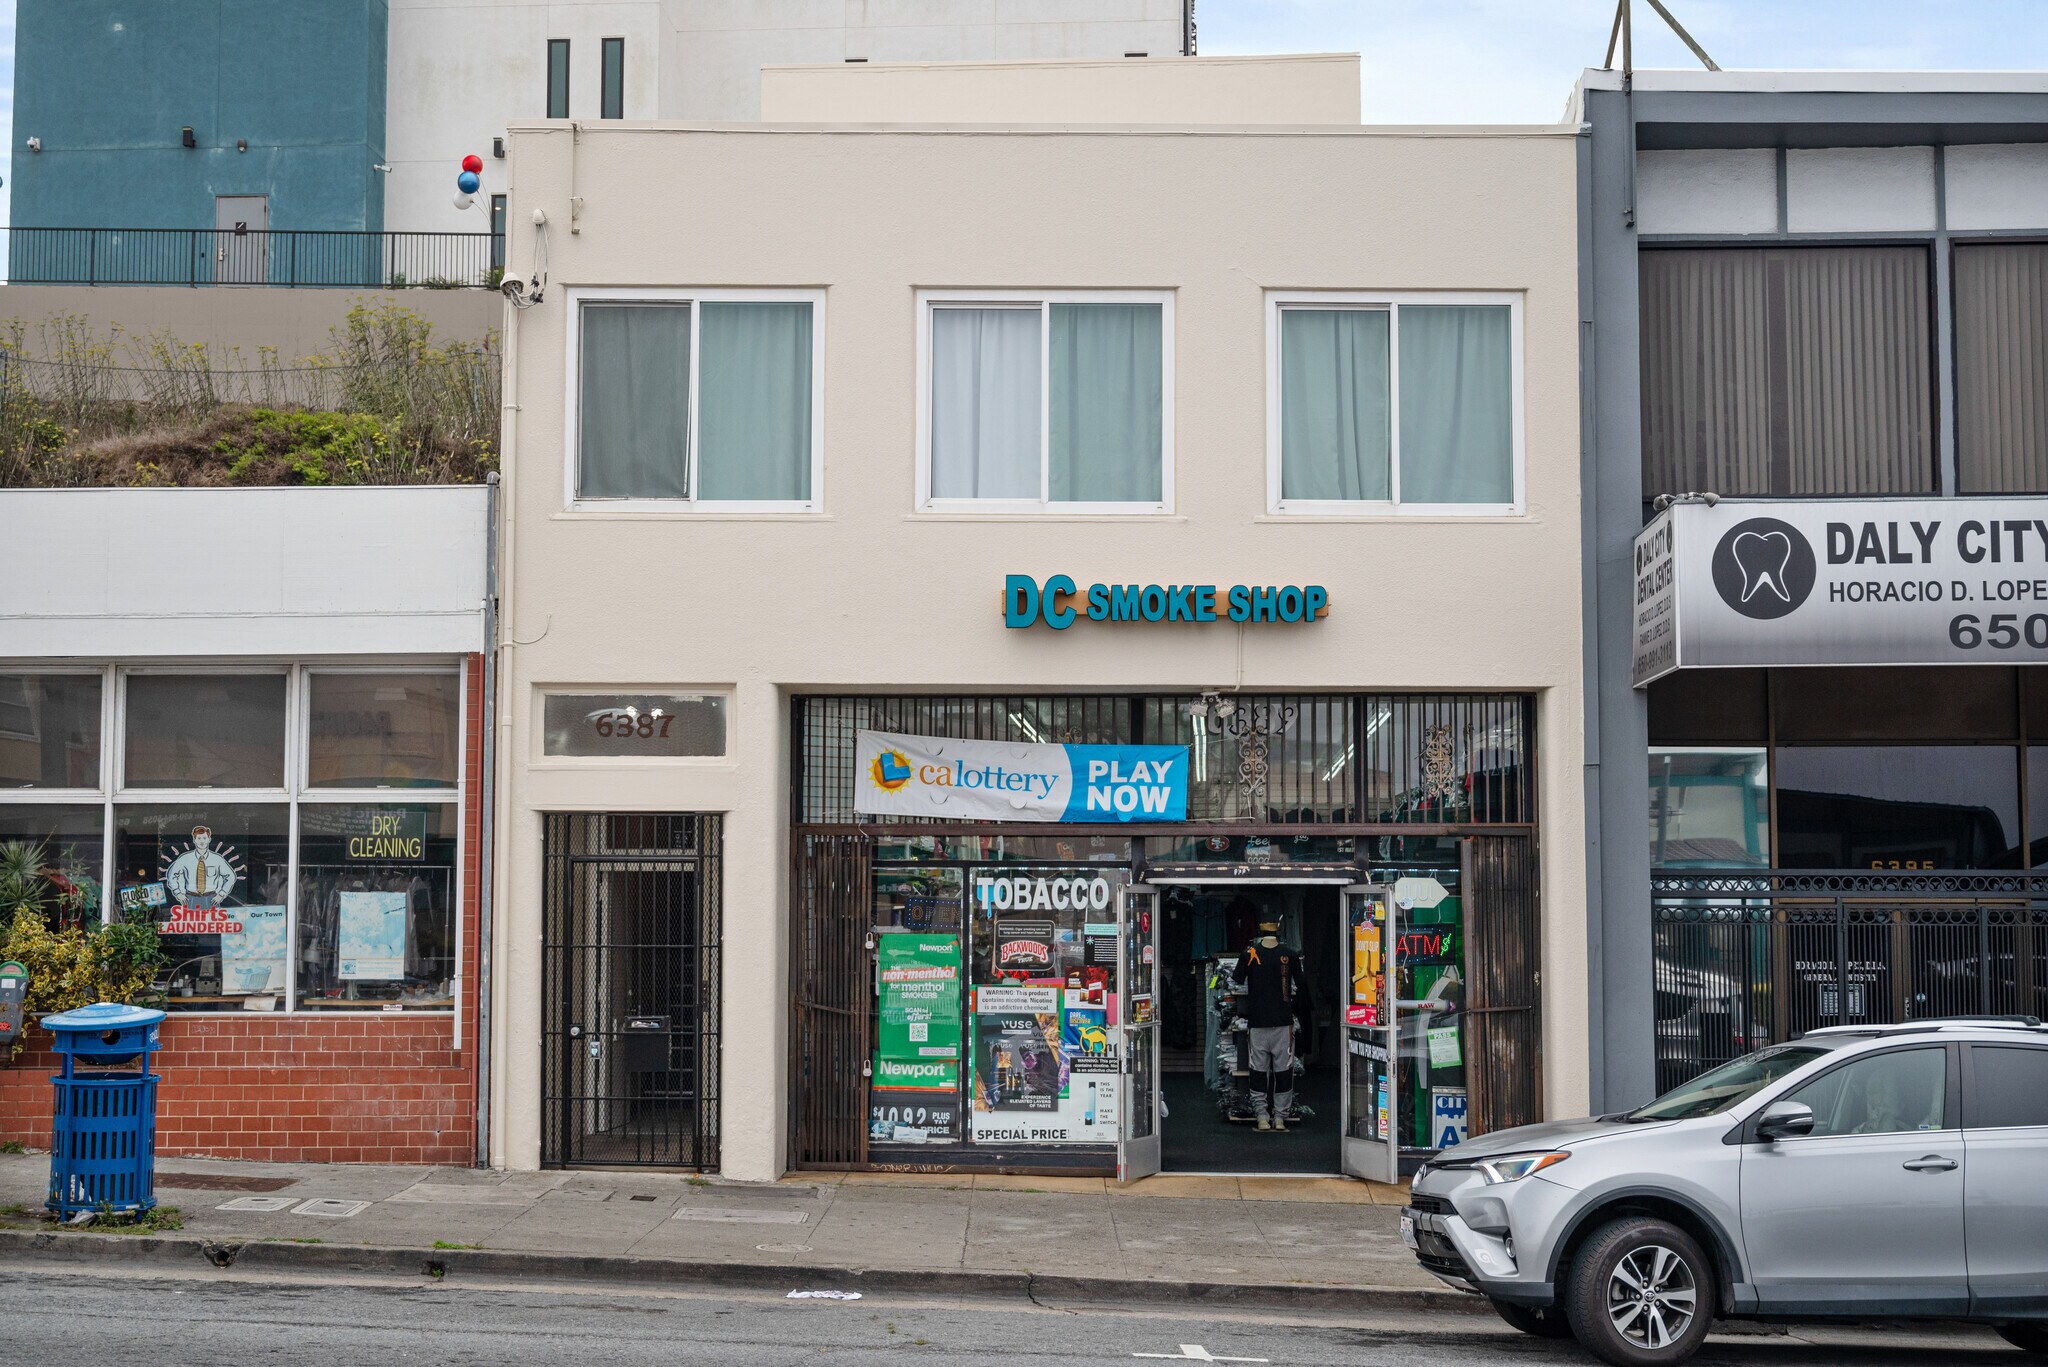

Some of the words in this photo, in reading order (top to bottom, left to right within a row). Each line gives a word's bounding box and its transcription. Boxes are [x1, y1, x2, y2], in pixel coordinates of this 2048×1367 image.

[1643, 535, 1654, 568] DALY
[1654, 526, 1666, 558] CITY
[1827, 521, 1941, 564] DALY
[1638, 572, 1654, 606] DENTAL
[1655, 557, 1672, 593] CENTER
[1830, 580, 1942, 602] HORACIO
[1951, 580, 1974, 601] D.
[1006, 574, 1077, 630] DC
[1087, 584, 1218, 622] SMOKE
[1228, 584, 1328, 622] SHOP
[1949, 614, 2048, 650] 650
[596, 712, 676, 738] 6387
[920, 760, 1059, 800] calottery
[1088, 760, 1174, 784] PLAY
[1086, 785, 1172, 814] NOW
[372, 816, 400, 836] DRY
[350, 838, 421, 858] CLEANING
[122, 890, 148, 902] CLOSED
[976, 877, 1110, 910] TOBACCO
[170, 904, 228, 922] Shirts
[912, 906, 961, 922] OPEN
[158, 922, 243, 933] LAUNDERED
[920, 944, 952, 953] Newport
[1002, 941, 1048, 961] BACKWOODS
[1396, 935, 1440, 955] ATM
[882, 966, 956, 981] non-menthol
[902, 982, 944, 991] menthol
[880, 1060, 945, 1078] Newport
[977, 1130, 1028, 1140] SPECIAL
[1032, 1130, 1067, 1140] PRICE
[1438, 1126, 1467, 1149] A
